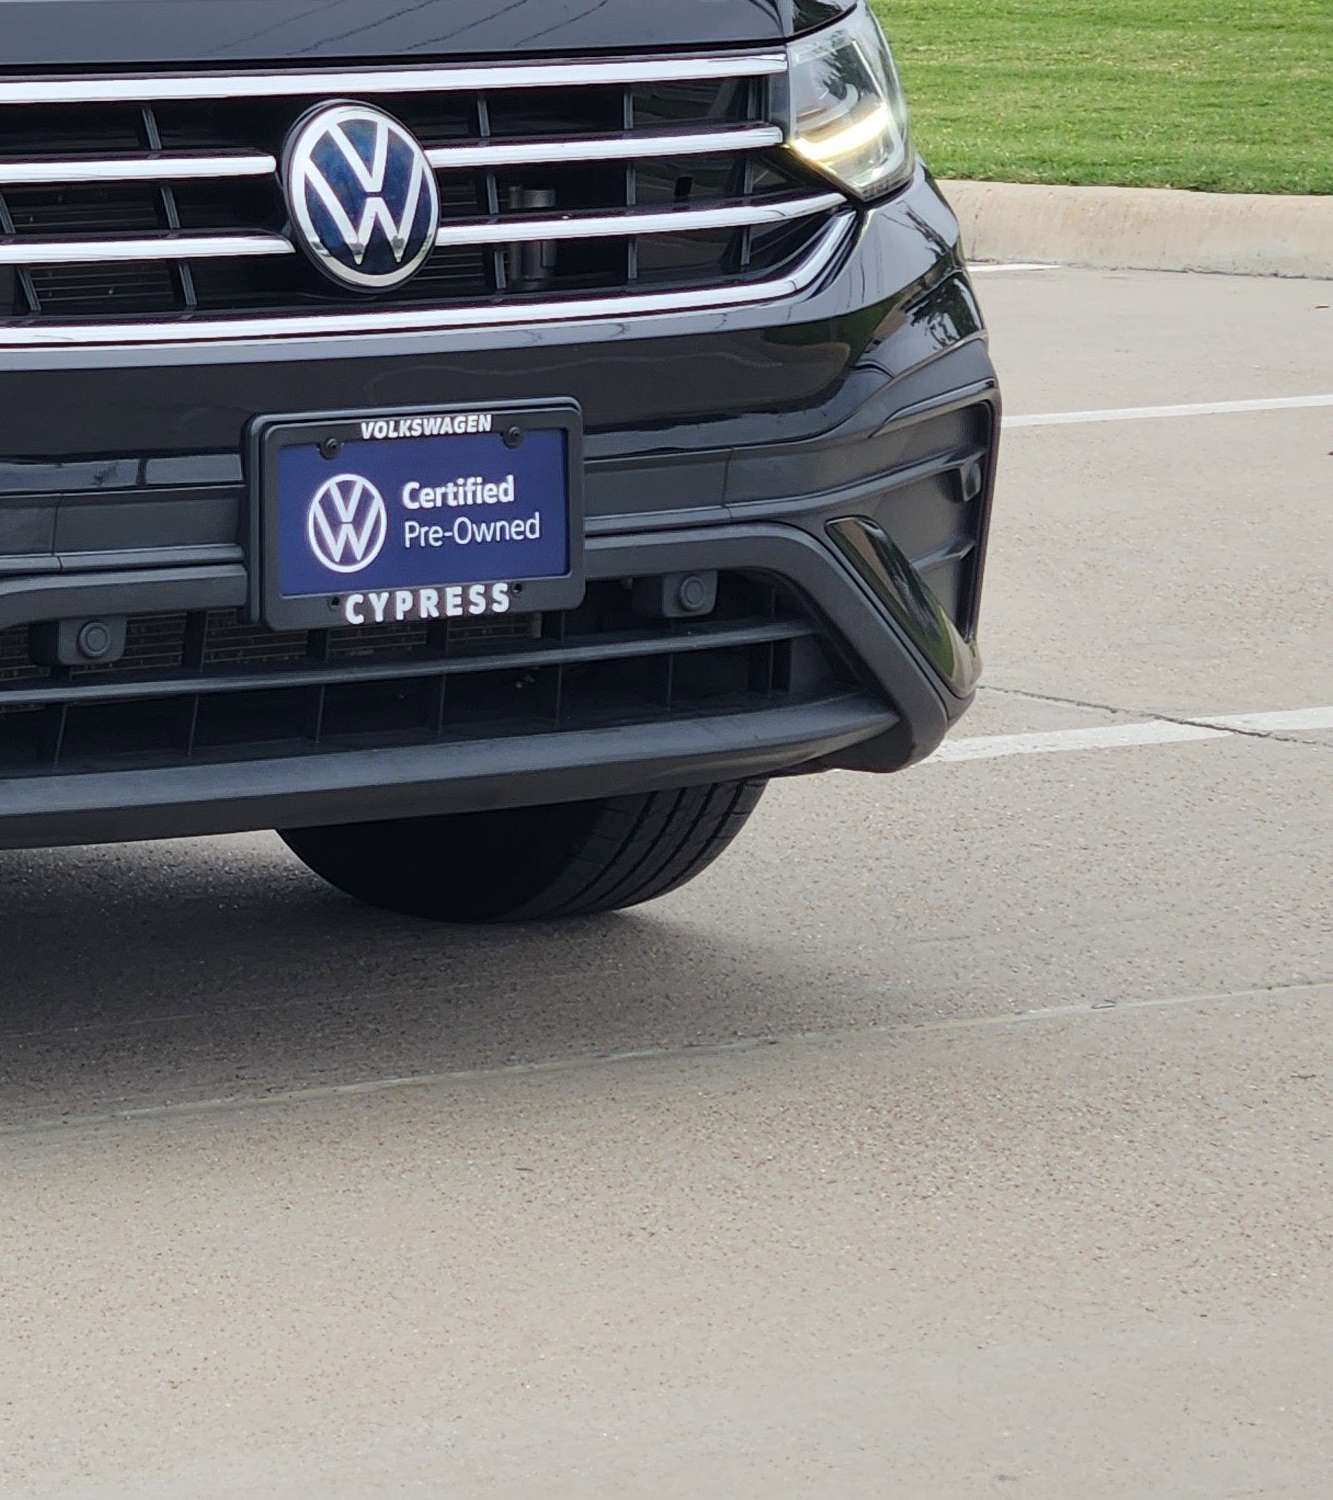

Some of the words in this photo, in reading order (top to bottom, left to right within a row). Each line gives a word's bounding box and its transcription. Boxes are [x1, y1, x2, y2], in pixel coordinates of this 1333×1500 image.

[295, 112, 435, 270] VW
[360, 414, 492, 440] VOLKSWAGEN
[402, 475, 515, 509] Certified
[311, 476, 384, 566] VW
[404, 512, 541, 548] Pre-Owned
[345, 582, 510, 625] CYPRESS
